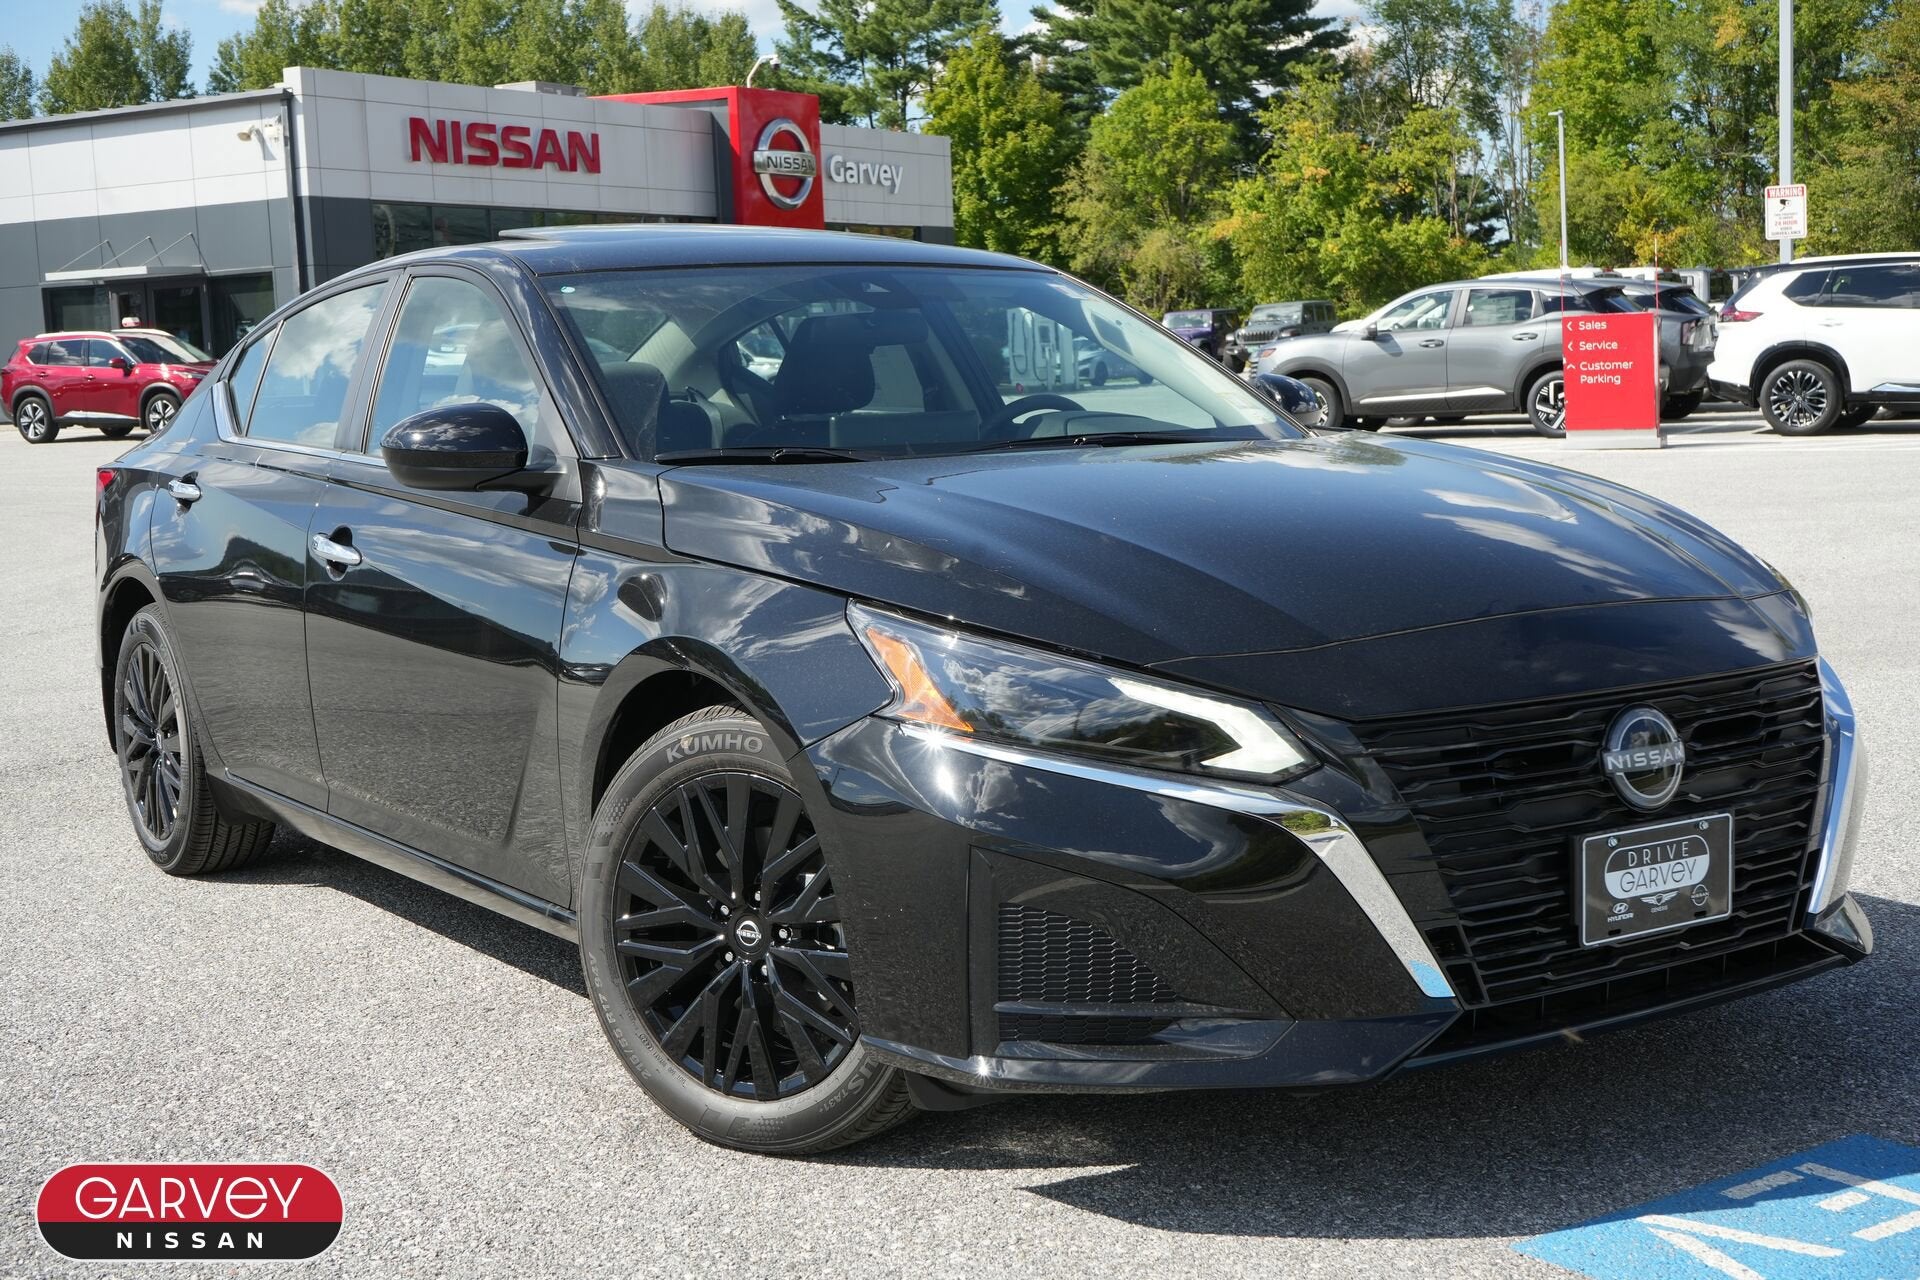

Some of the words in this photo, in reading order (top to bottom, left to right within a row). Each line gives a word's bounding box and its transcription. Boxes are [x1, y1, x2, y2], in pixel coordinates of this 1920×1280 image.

[409, 117, 601, 174] NISSAN
[766, 155, 815, 172] NISSAN
[830, 155, 903, 194] Garvey
[1769, 187, 1803, 198] WARNING
[1578, 320, 1607, 331] Sales
[1579, 340, 1618, 351] Service
[1580, 361, 1633, 371] Customer
[1580, 374, 1621, 385] Parking
[666, 733, 763, 764] KUMHO
[1607, 745, 1684, 770] NISSAN
[1628, 841, 1689, 867] DRIVE
